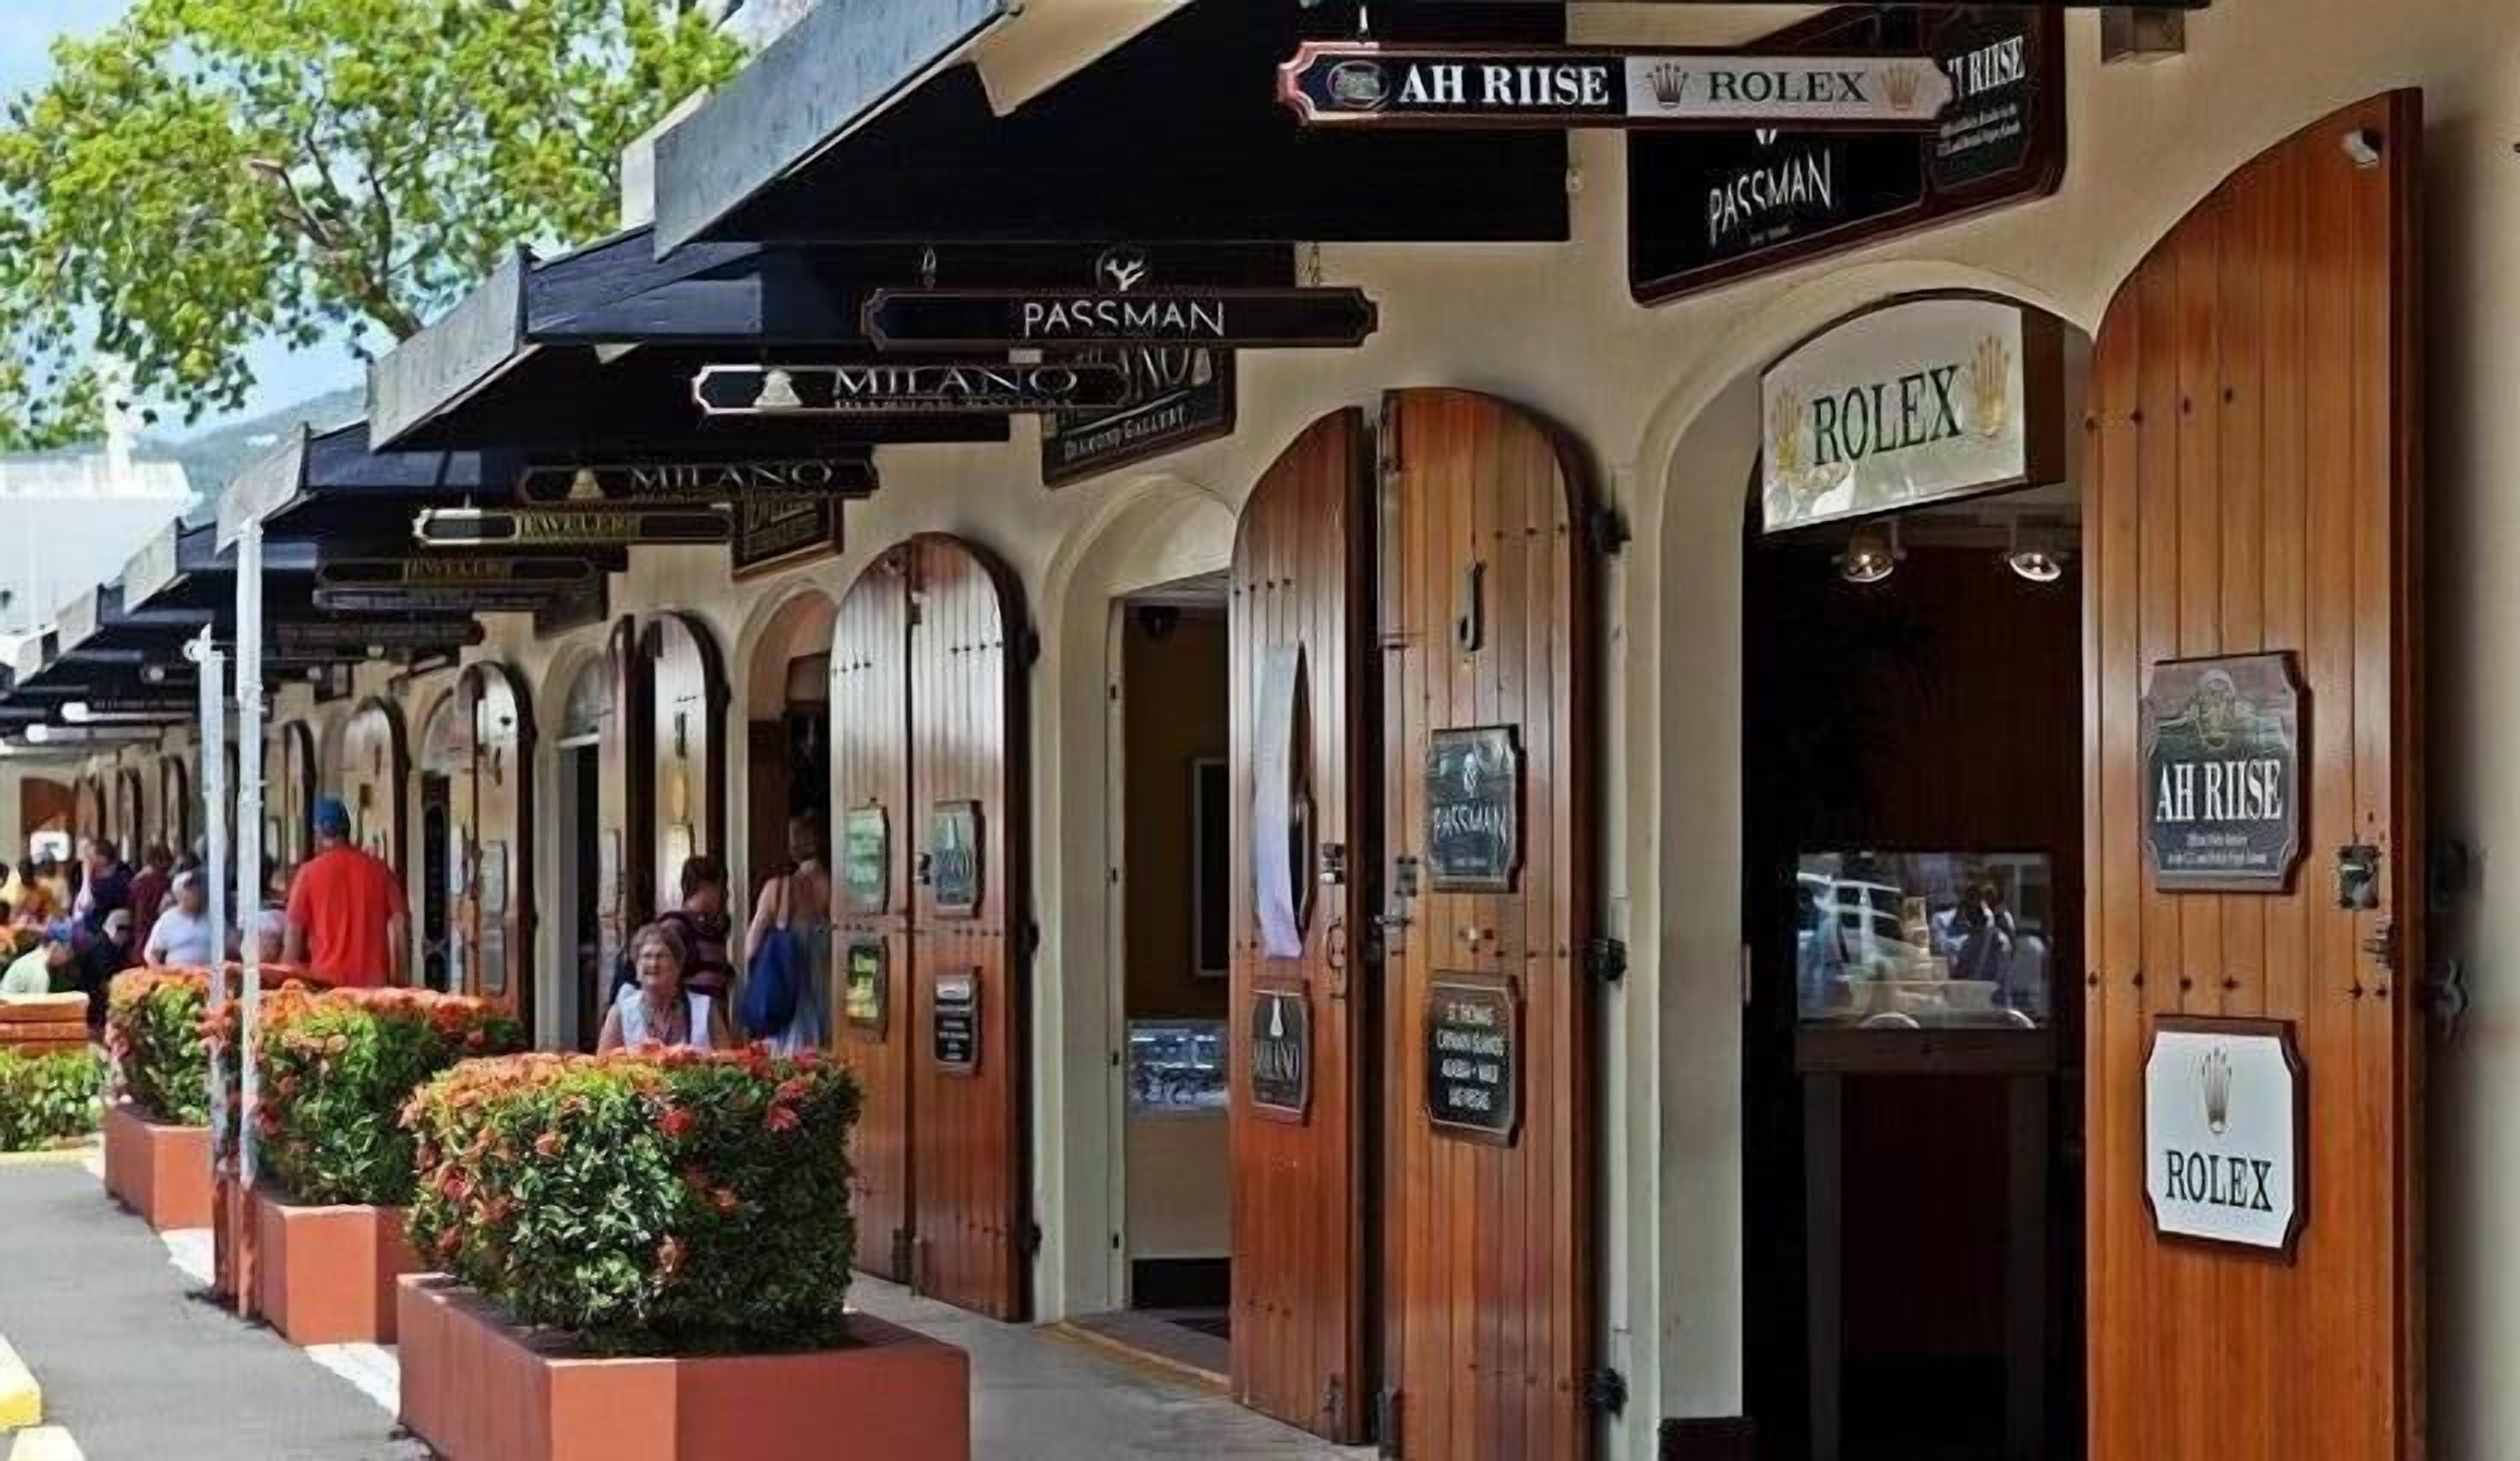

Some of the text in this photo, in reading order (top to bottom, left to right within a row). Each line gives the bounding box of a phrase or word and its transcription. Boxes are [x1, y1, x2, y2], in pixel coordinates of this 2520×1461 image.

[1399, 63, 1610, 106] AH RIISE
[1708, 70, 1870, 103] ROLEX
[1967, 34, 2025, 96] RIISE
[1708, 147, 1832, 249] PASSMAN
[1024, 300, 1224, 337] PASSMAN
[832, 365, 1078, 397] MILANO
[1812, 364, 1964, 466] ROLEX
[2155, 759, 2282, 822] AH RIISE
[2166, 1149, 2273, 1212] ROLEX
